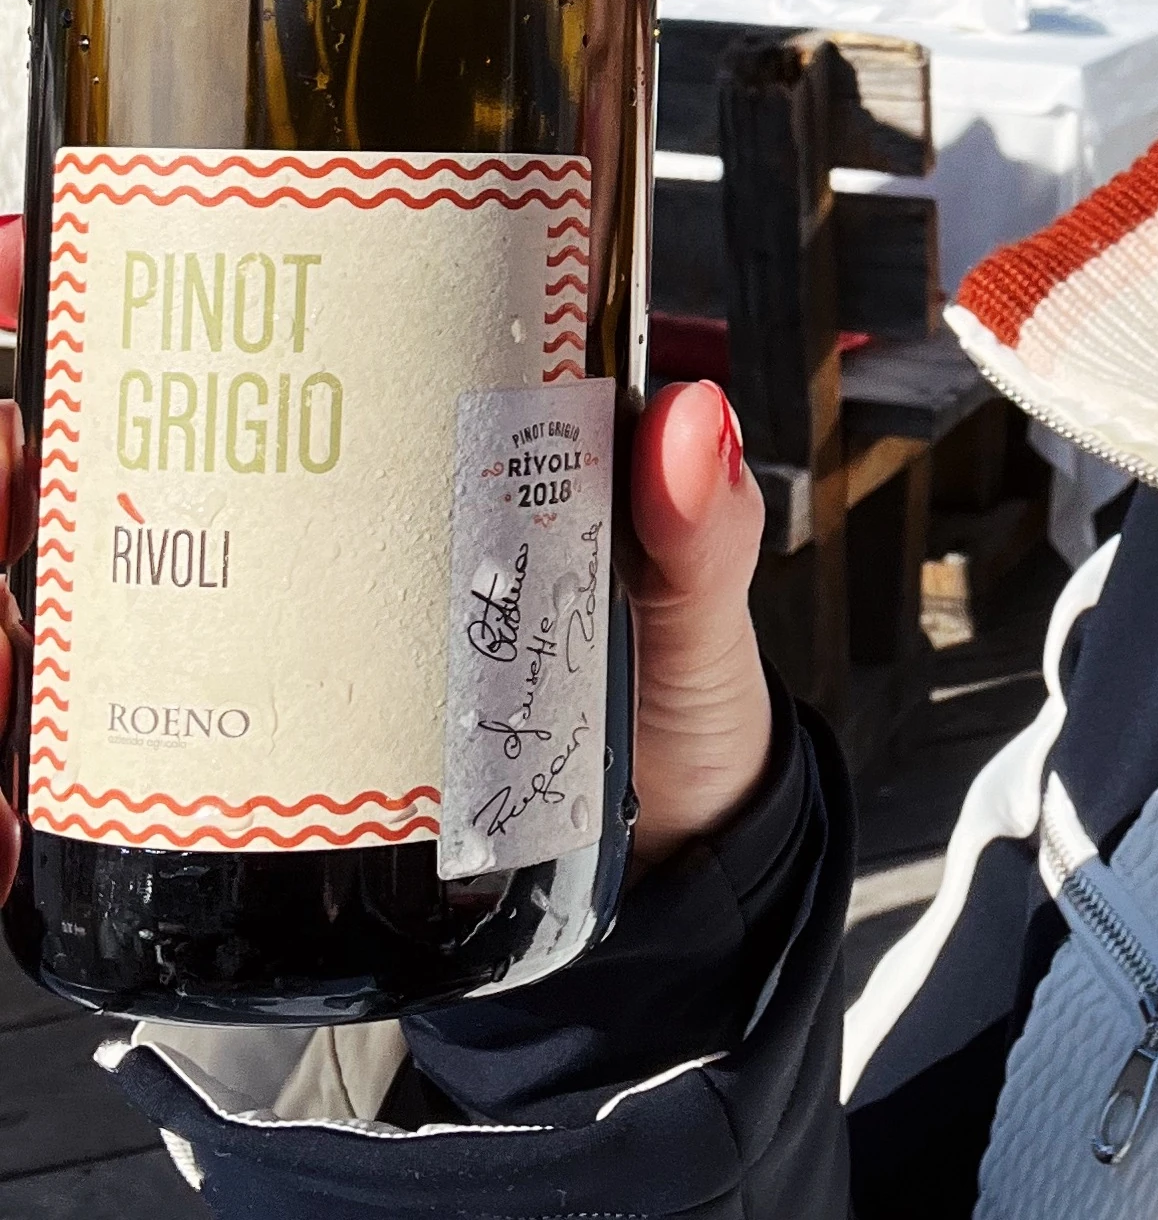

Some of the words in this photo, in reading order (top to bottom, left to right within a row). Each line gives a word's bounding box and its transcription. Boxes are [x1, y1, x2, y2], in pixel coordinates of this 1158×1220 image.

[122, 250, 322, 353] PINOT
[117, 369, 343, 474] GRIGIO
[511, 422, 546, 449] PINOT
[548, 421, 580, 442] GRIGIO
[518, 479, 572, 508] 2018
[107, 702, 251, 738] ROENO
